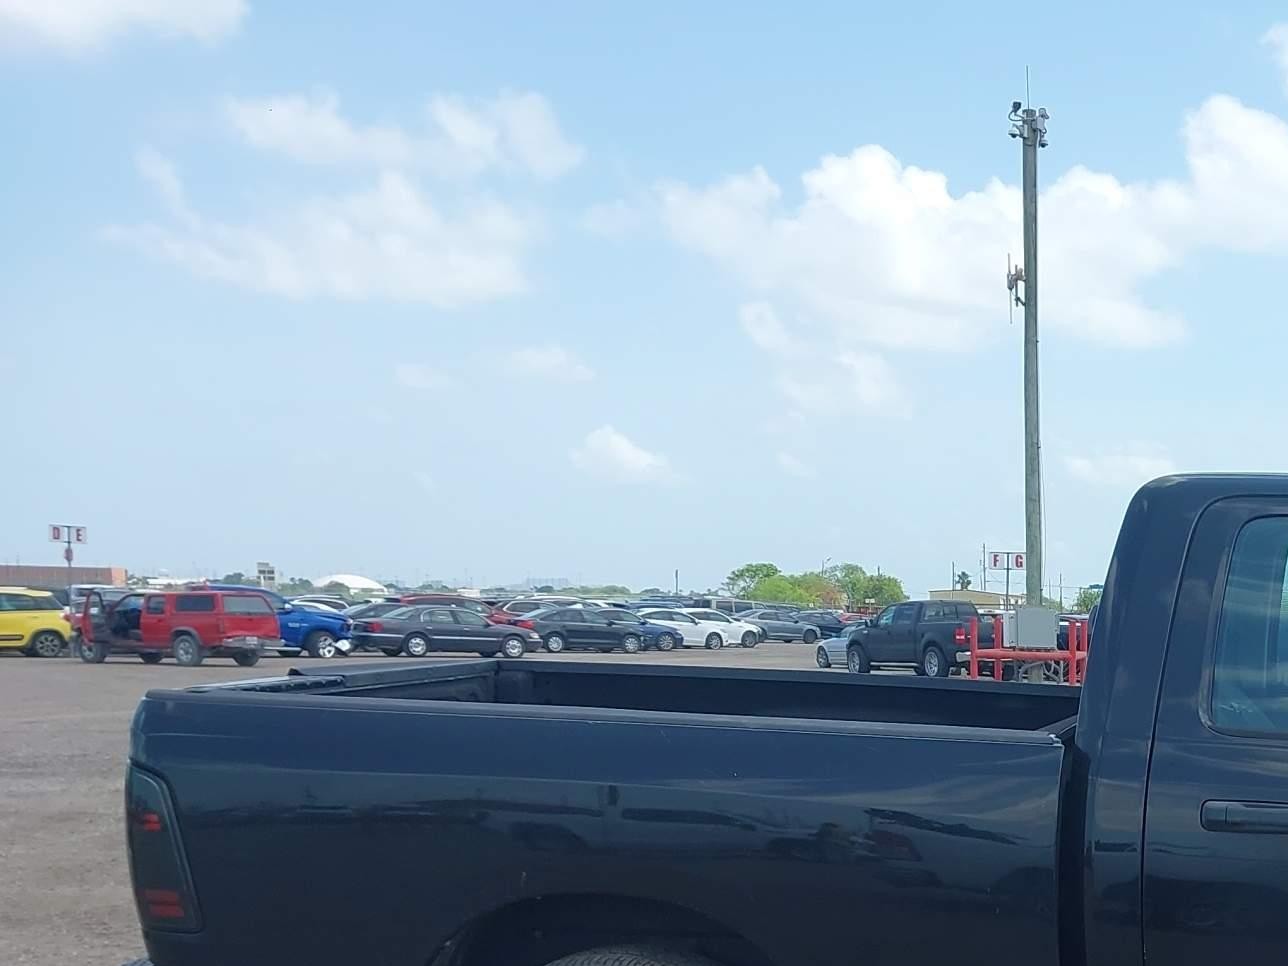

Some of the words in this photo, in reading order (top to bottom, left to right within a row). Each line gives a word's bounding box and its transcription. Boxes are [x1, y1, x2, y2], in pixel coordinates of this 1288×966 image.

[52, 526, 61, 540] D
[76, 528, 83, 542] E
[993, 554, 1000, 568] F
[1015, 554, 1024, 569] G
